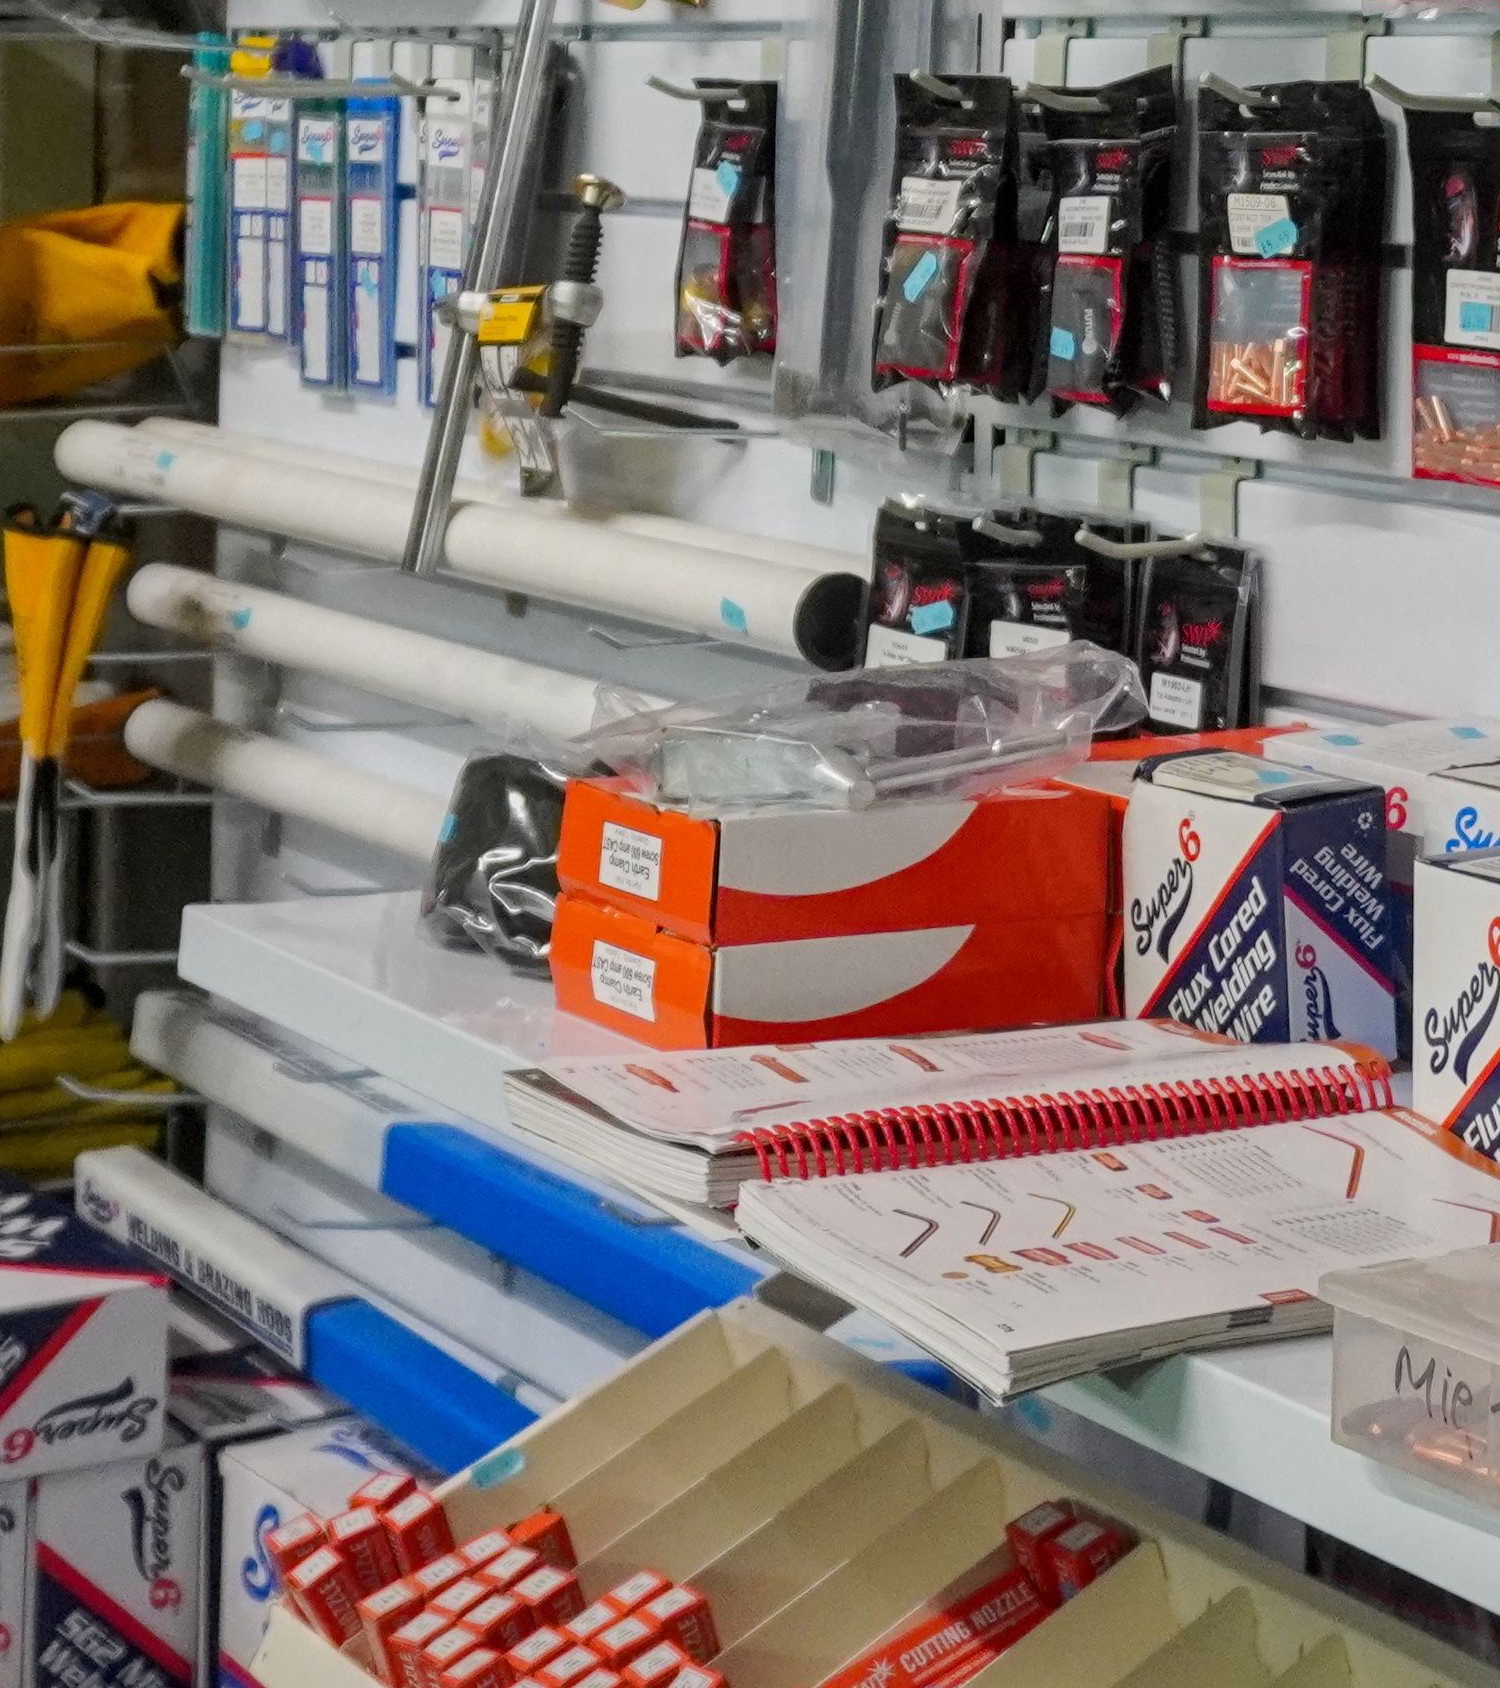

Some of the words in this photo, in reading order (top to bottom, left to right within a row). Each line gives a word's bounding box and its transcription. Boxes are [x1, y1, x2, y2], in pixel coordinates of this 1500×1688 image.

[1233, 196, 1276, 209] M1509-06
[608, 855, 630, 873] Clamp
[631, 862, 650, 881] Earth
[1168, 959, 1214, 1021] Flux
[1207, 874, 1270, 970] Cored
[624, 983, 643, 1002] Earth
[1195, 932, 1277, 1040] Welding
[1224, 982, 1278, 1046] Wire
[124, 1215, 181, 1272] WELDING
[195, 1260, 252, 1316] BRAZING
[251, 1293, 295, 1344] RODS
[899, 1620, 972, 1674] CUTTING
[970, 1580, 1032, 1633] NOZZLE
